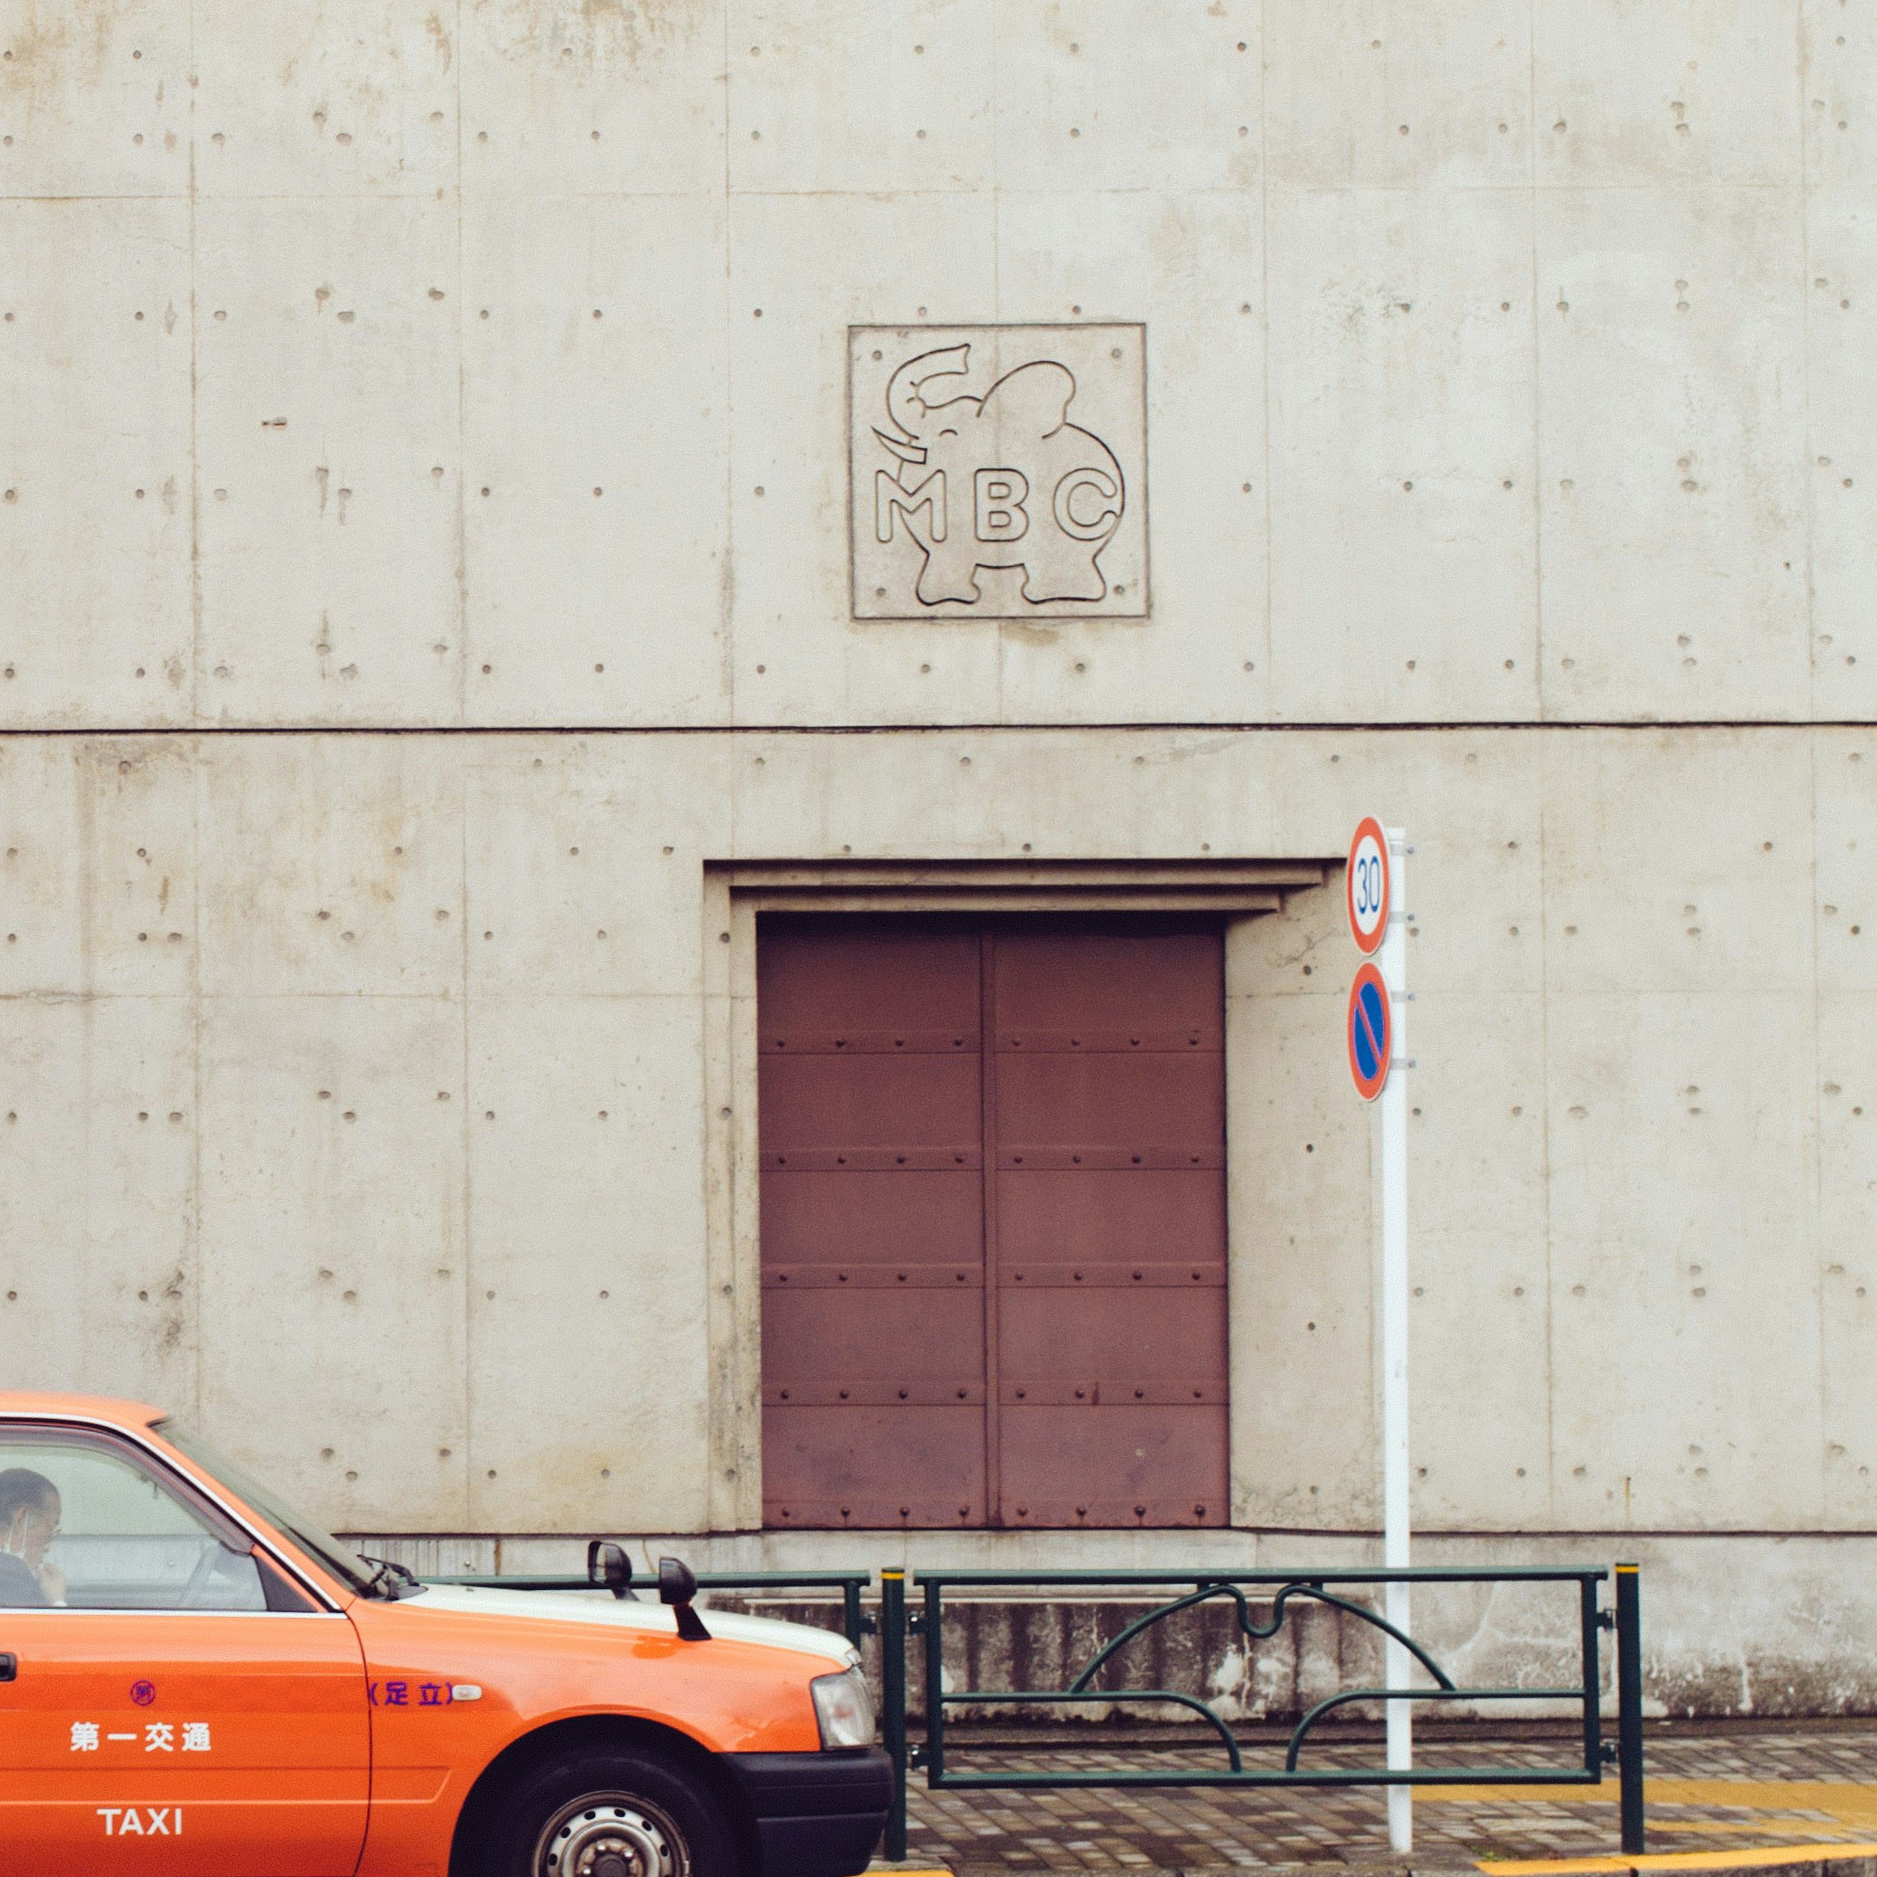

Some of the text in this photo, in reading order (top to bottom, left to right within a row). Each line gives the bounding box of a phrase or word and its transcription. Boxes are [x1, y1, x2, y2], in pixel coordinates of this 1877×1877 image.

[875, 468, 1120, 543] MBC
[1357, 855, 1380, 914] 30
[70, 1721, 211, 1752] 第一交通
[96, 1808, 182, 1836] TAXI
